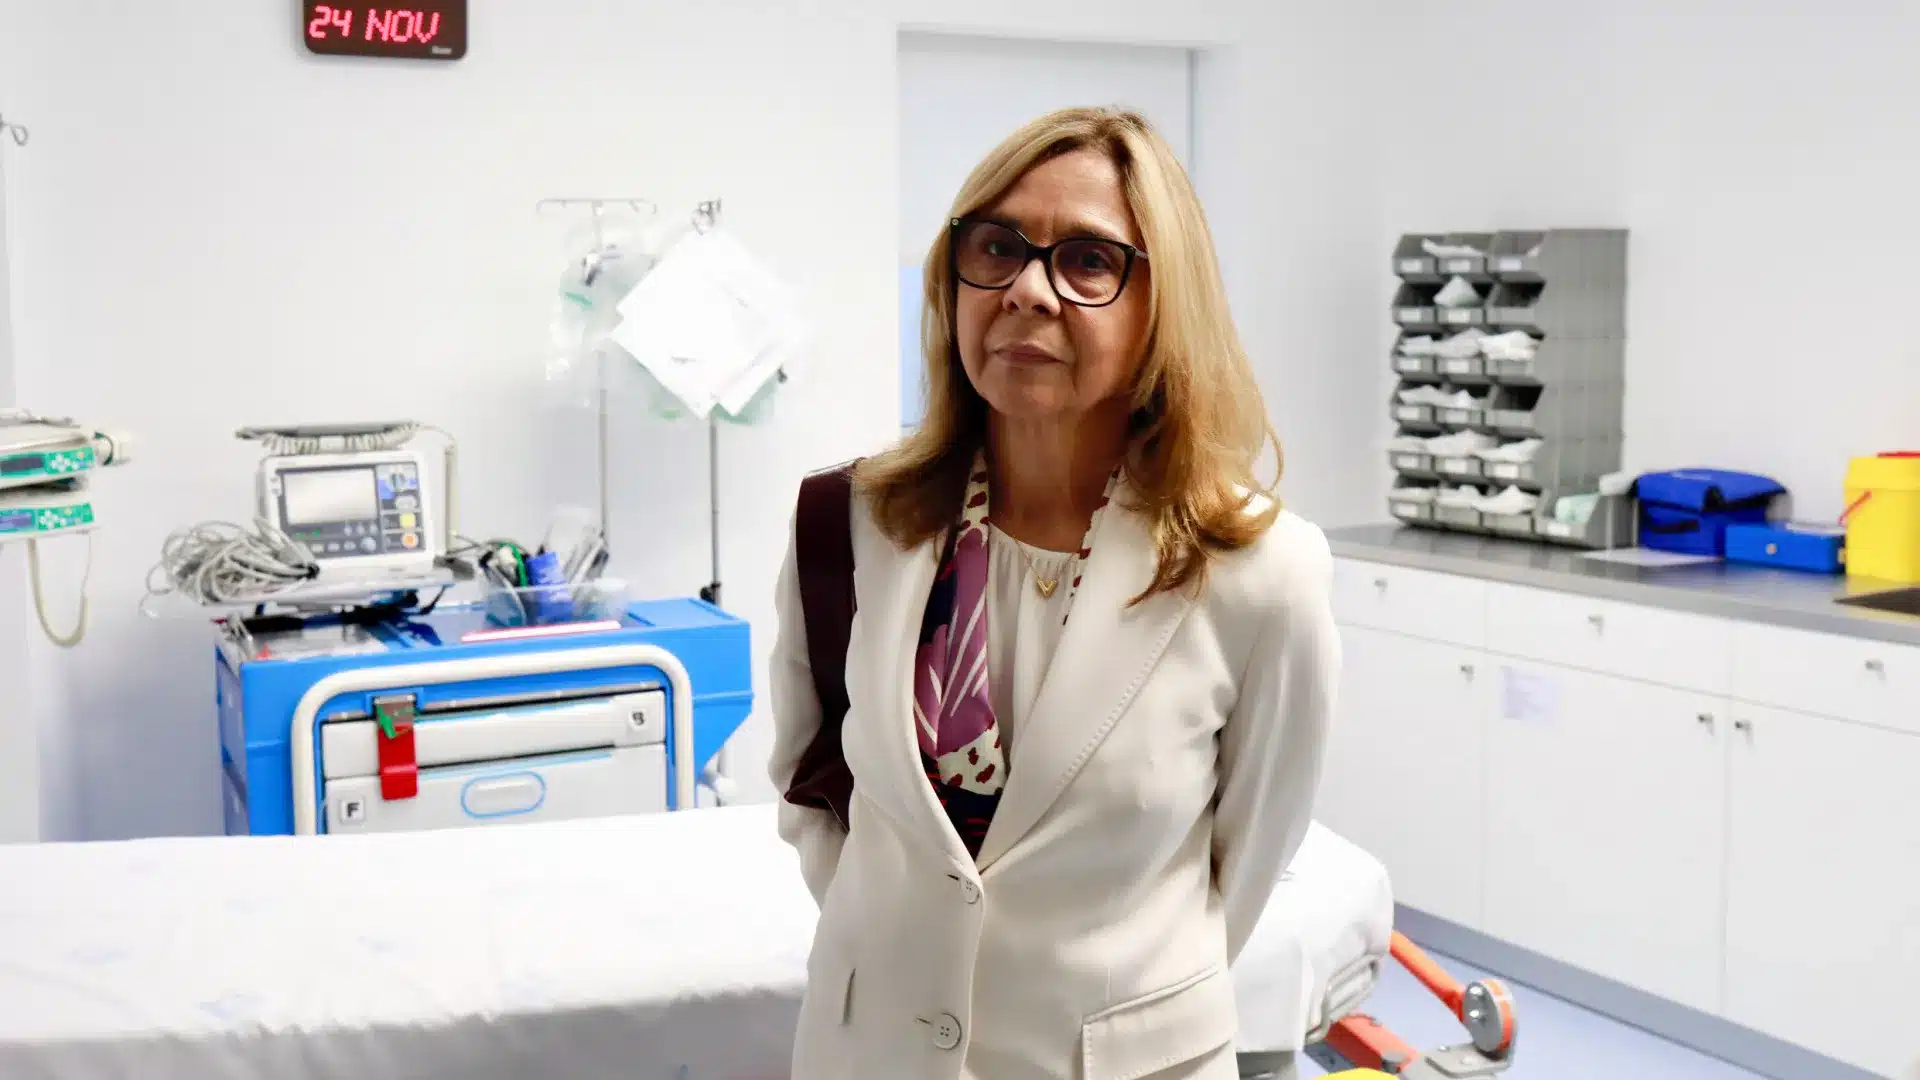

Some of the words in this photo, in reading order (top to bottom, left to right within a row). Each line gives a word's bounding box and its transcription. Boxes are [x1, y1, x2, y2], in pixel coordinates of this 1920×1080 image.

[309, 5, 353, 39] 24
[365, 8, 440, 43] NOV
[347, 802, 360, 818] F
